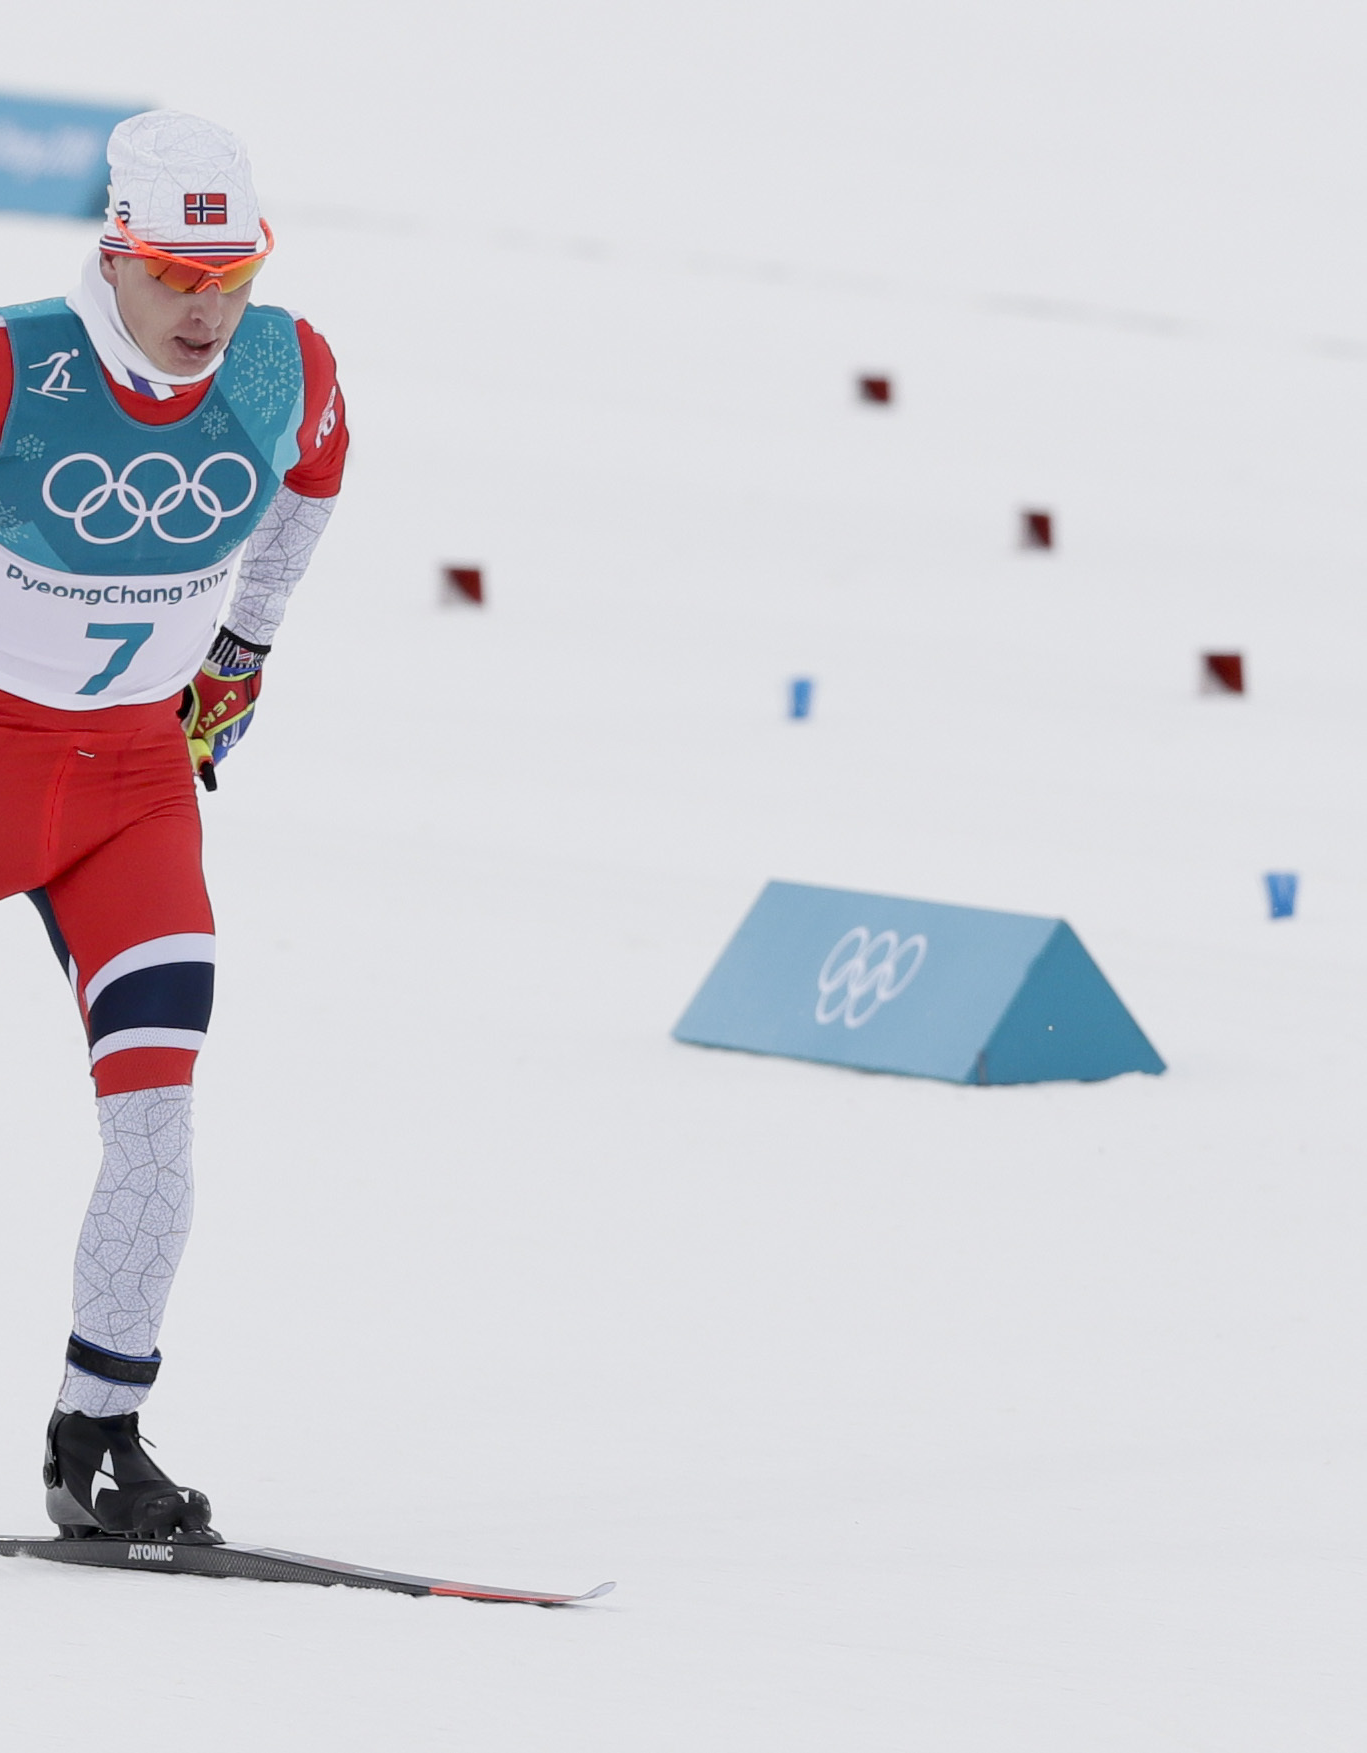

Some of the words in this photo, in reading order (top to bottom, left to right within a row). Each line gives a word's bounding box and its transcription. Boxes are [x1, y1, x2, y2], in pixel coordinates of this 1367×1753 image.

[6, 563, 182, 605] PyeongChang
[75, 622, 155, 696] 7
[196, 689, 237, 733] LEKI
[128, 1544, 174, 1562] ATOMIC
